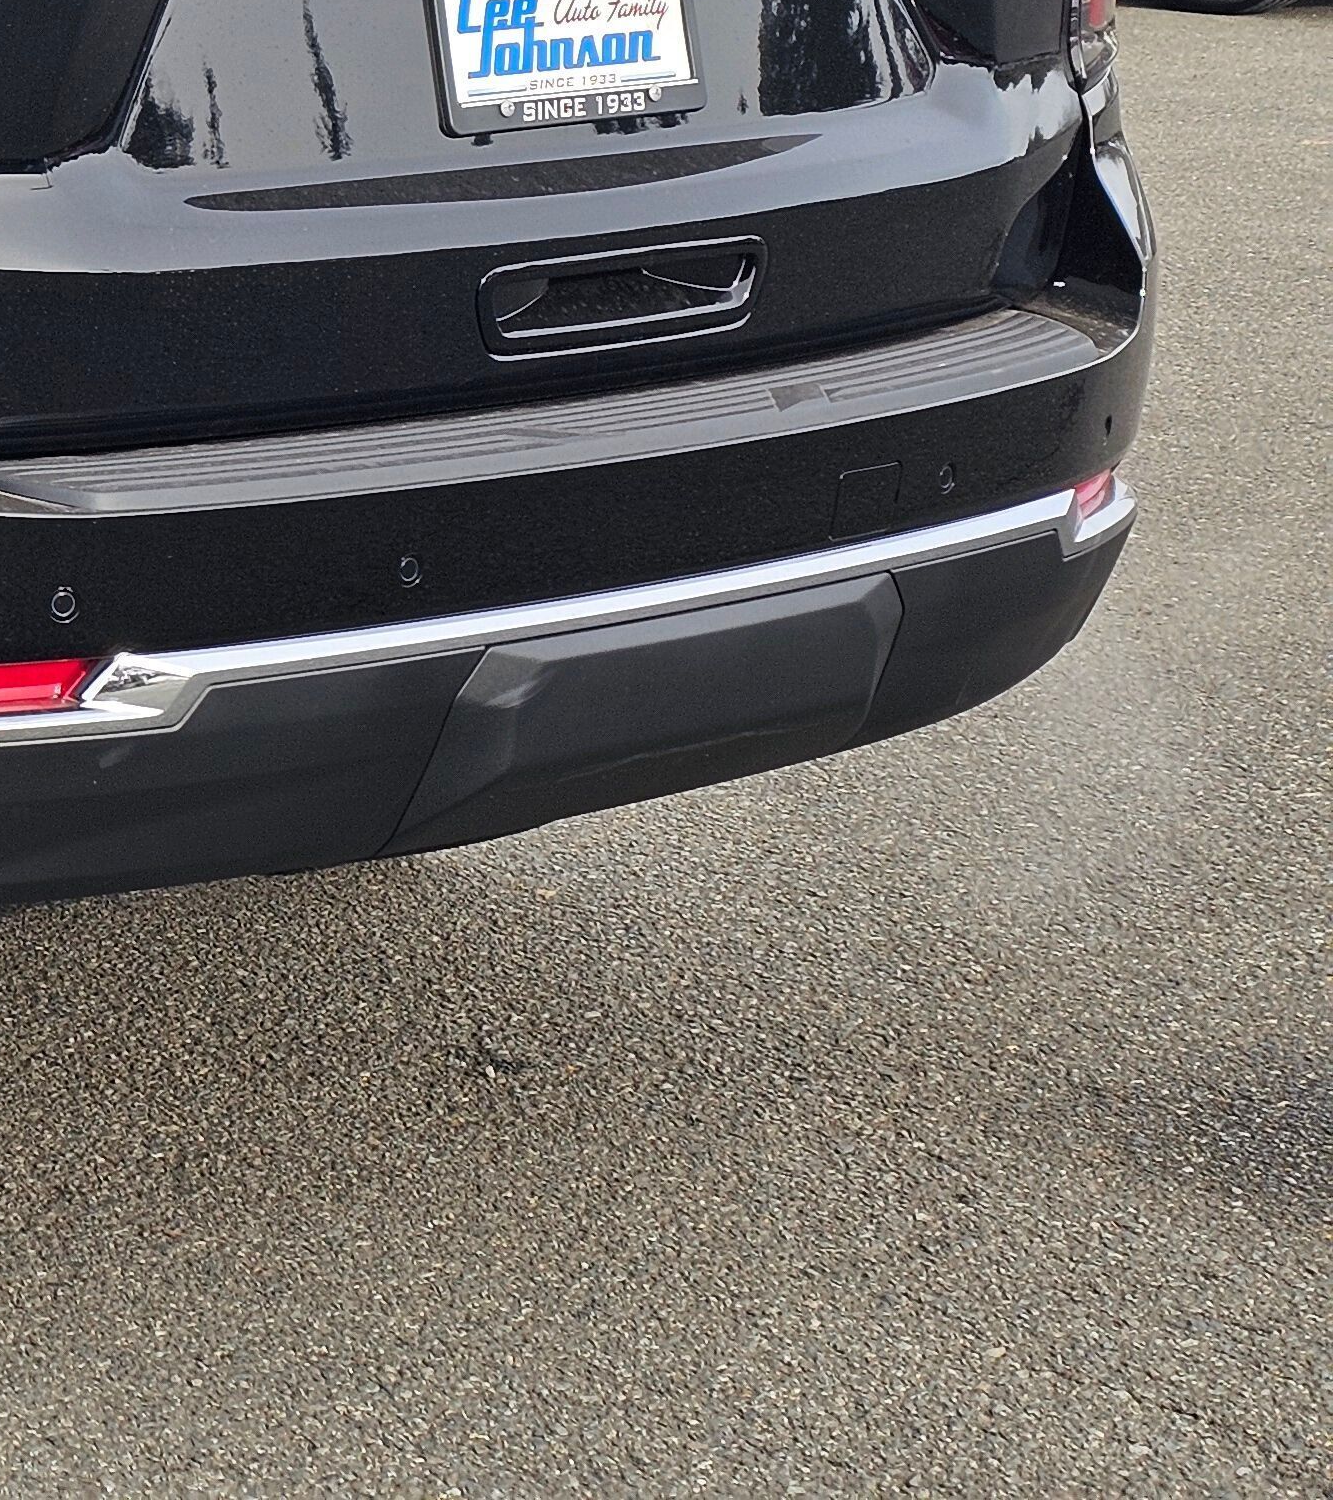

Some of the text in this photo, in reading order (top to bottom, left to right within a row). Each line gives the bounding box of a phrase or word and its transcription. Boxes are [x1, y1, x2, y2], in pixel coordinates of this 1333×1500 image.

[468, 18, 661, 79] Johnson
[529, 73, 617, 91] SINCE 1933
[522, 91, 646, 123] SINCE 1933
